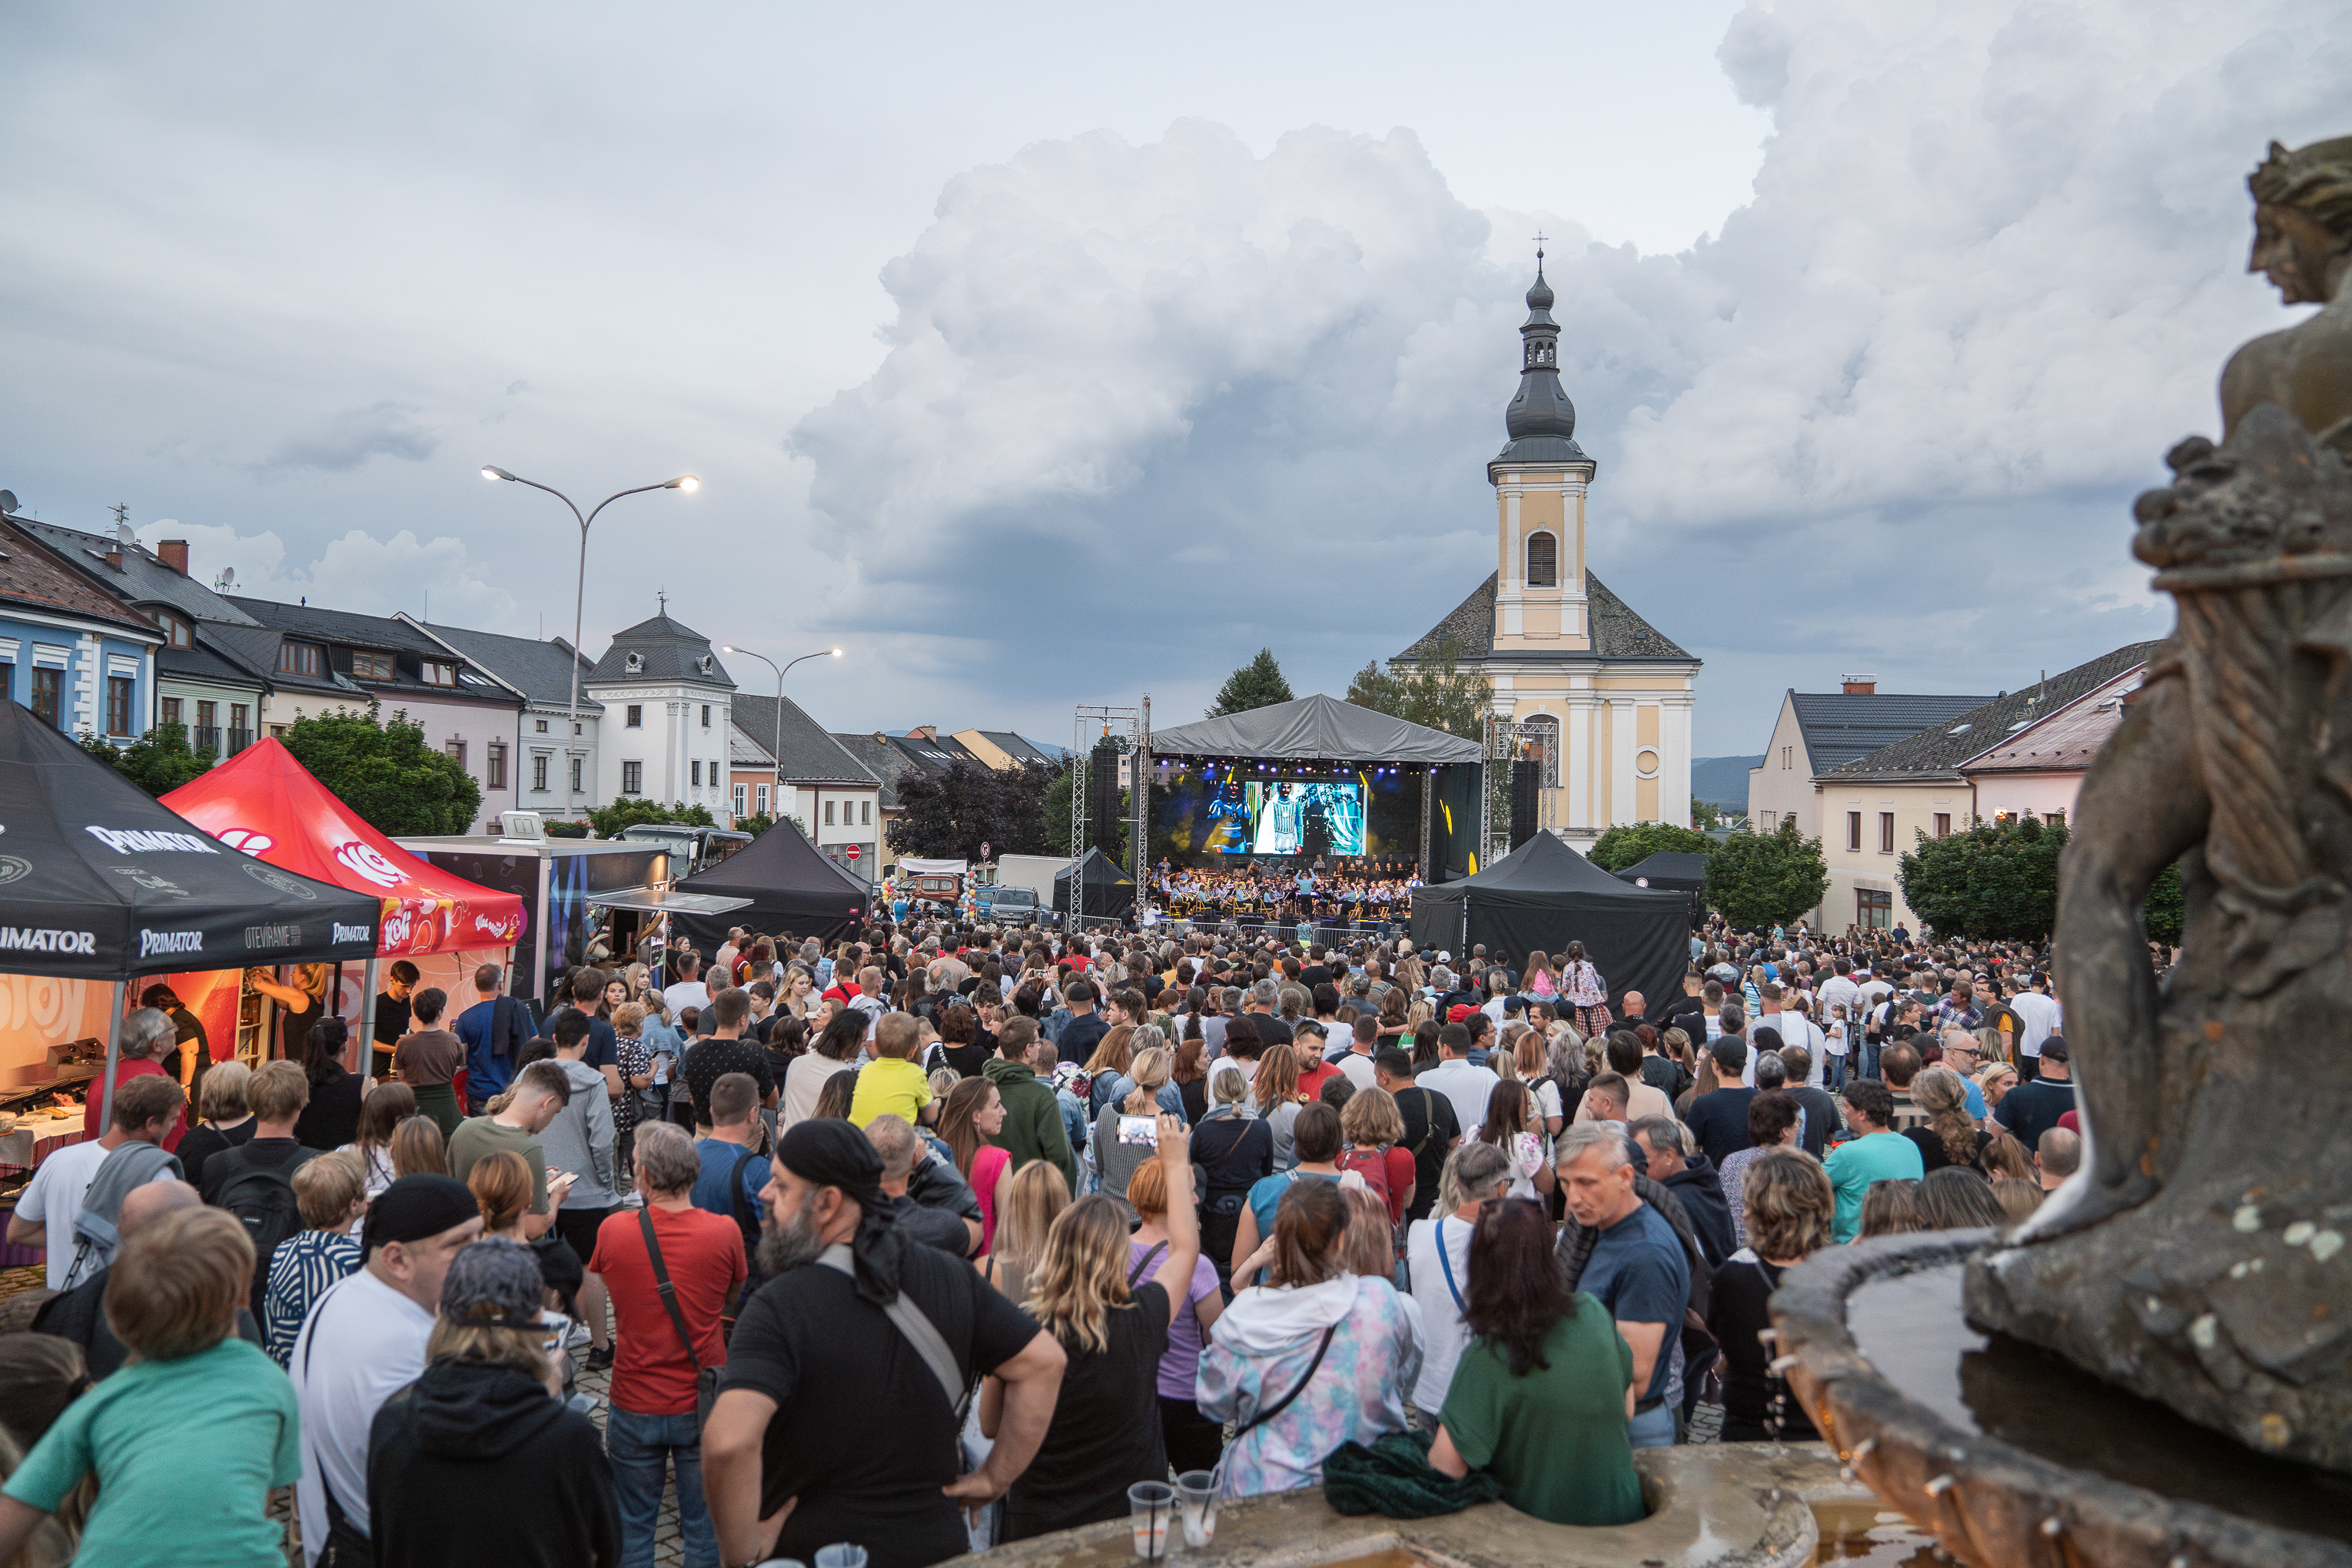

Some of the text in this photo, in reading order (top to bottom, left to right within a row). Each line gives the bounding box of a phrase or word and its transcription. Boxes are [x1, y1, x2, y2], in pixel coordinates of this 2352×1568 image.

[0, 926, 96, 955] IMATOR
[140, 929, 203, 958] PRIMATOR
[245, 922, 290, 948] OTEVÍRÁME
[331, 922, 370, 945] PRIMATOR
[384, 910, 412, 952] Koli
